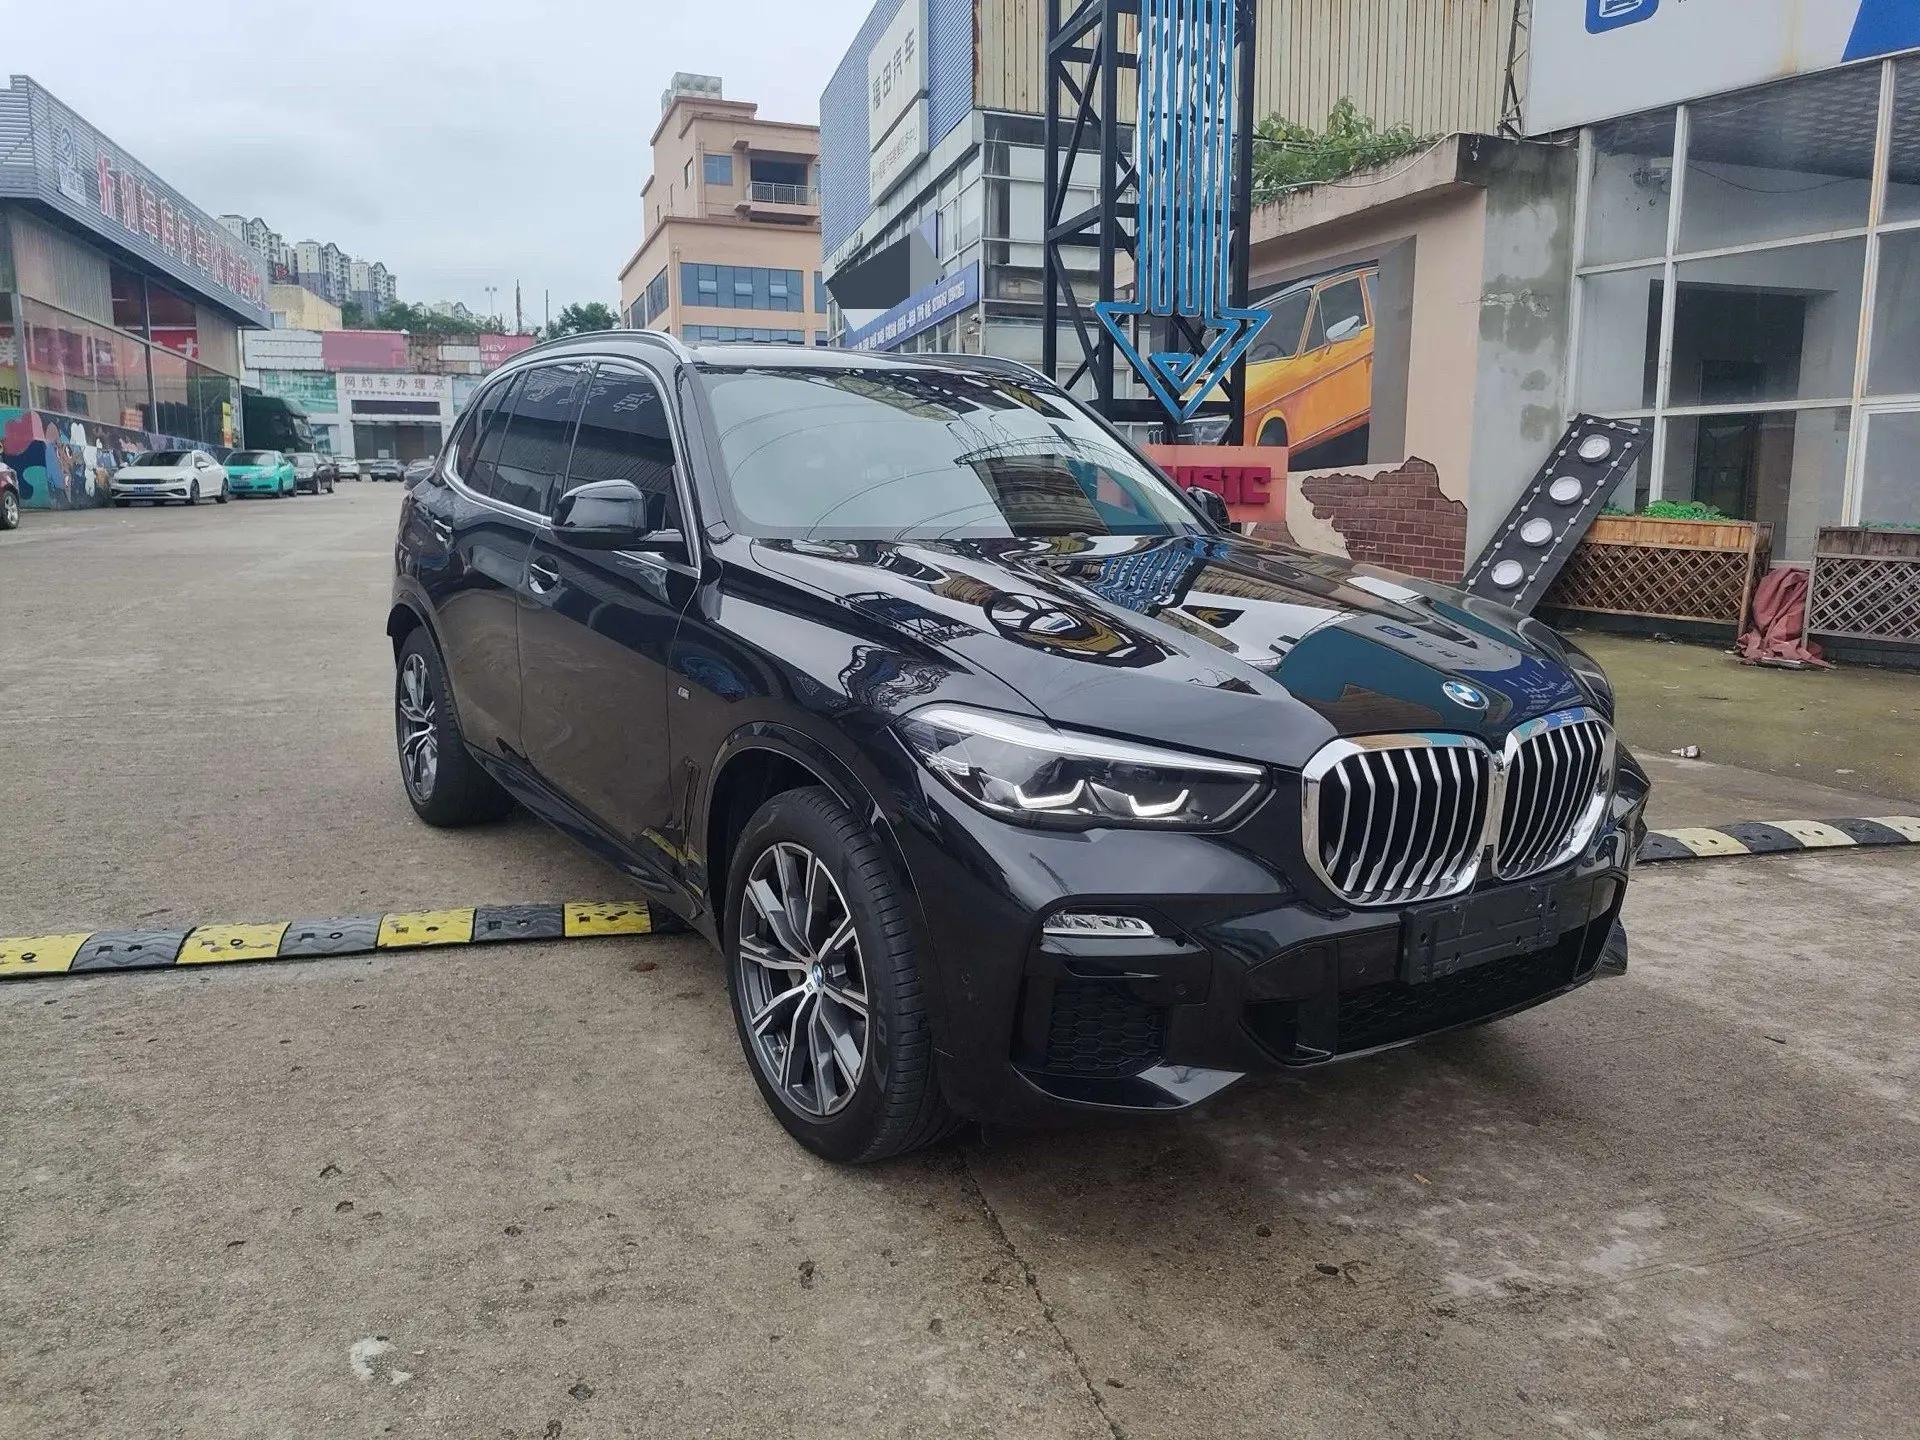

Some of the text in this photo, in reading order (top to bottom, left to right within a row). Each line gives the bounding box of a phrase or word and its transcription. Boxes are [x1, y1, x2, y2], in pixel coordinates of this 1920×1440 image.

[344, 375, 445, 390] 网约车办理点
